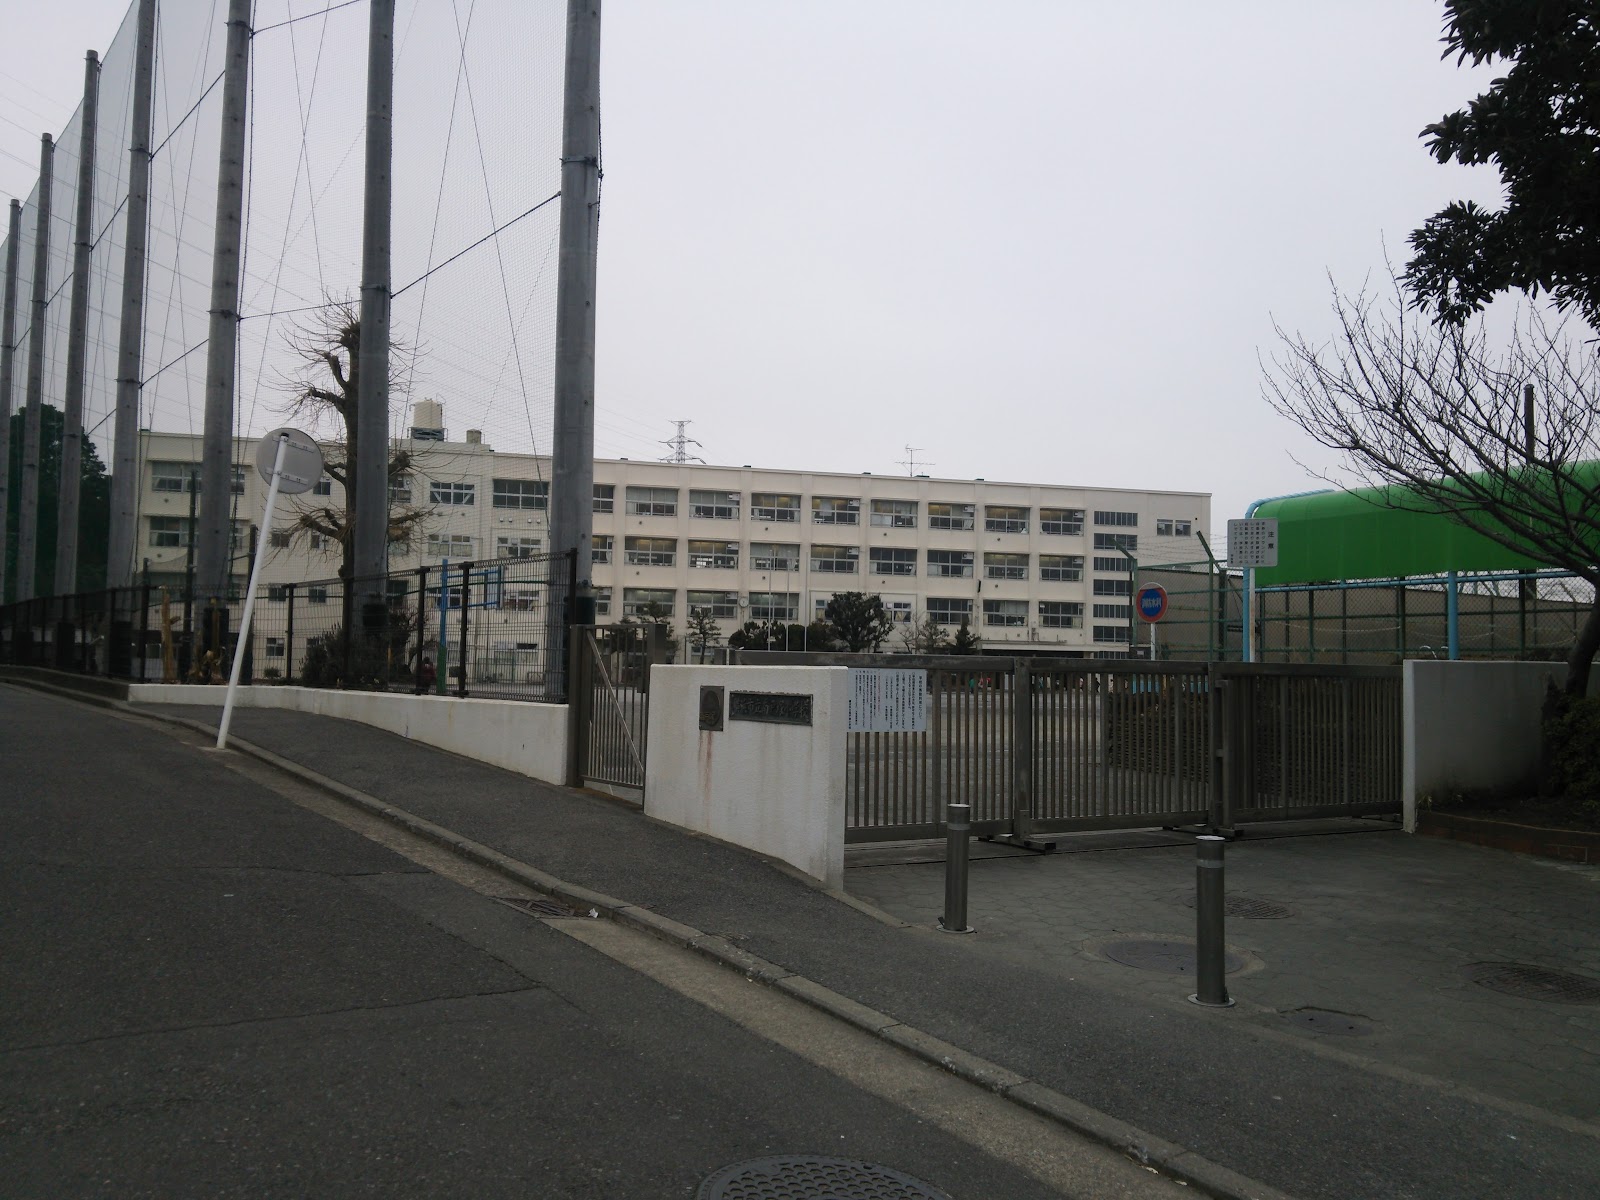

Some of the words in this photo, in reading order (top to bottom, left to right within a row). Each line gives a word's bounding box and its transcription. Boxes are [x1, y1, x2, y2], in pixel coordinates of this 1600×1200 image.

[1267, 531, 1275, 550] 注意
[1141, 597, 1162, 609] 消防水利
